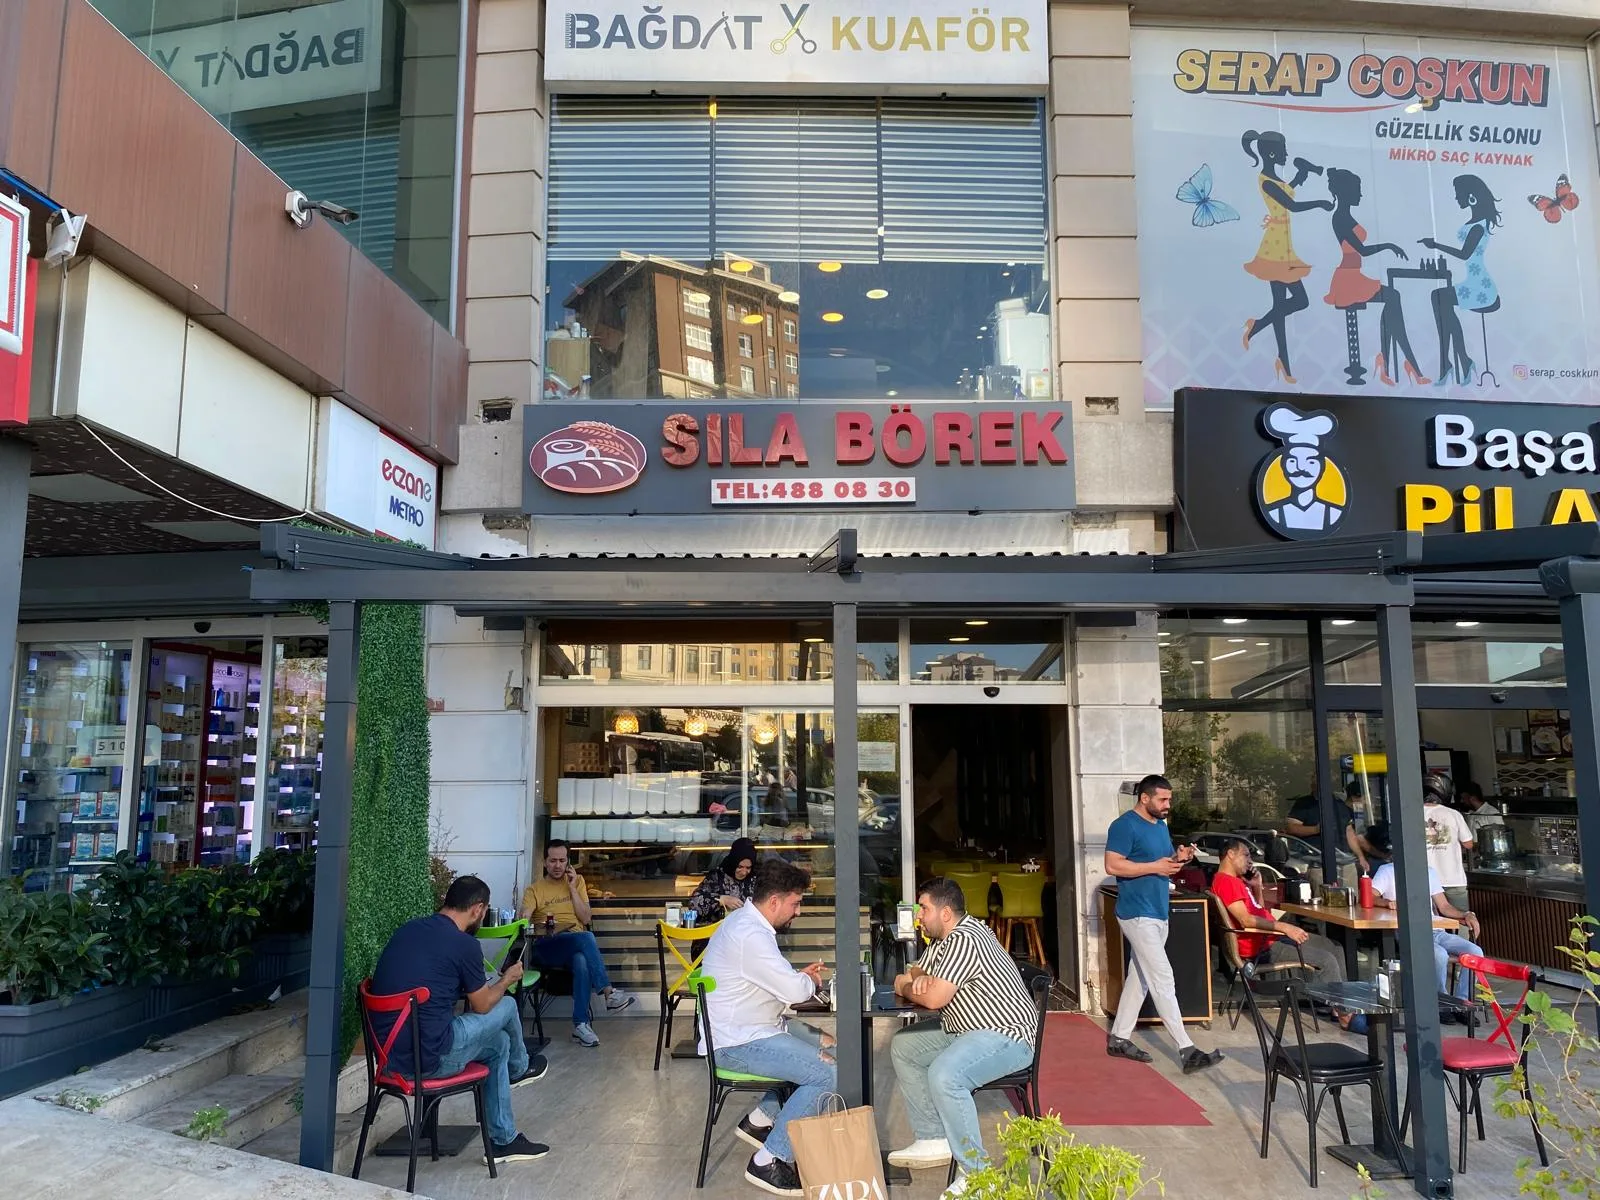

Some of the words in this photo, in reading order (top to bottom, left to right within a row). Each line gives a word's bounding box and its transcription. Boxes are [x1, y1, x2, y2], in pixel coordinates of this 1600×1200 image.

[565, 6, 763, 50] BAĞDAT
[832, 8, 1030, 51] KUAFÖR
[1173, 49, 1341, 97] SERAP
[1348, 53, 1550, 111] COŞKUN
[1375, 118, 1464, 141] GÜZELLİK
[1469, 125, 1541, 145] SALONU
[1389, 145, 1437, 162] MİKRO
[1440, 151, 1470, 167] SAÇ
[1474, 151, 1533, 166] KAYNAK
[1529, 368, 1599, 379] serap_coskkun
[661, 413, 809, 467] SILA
[835, 404, 1068, 466] BÖREK
[1434, 414, 1597, 477] Başa
[382, 458, 432, 503] eczane
[716, 482, 824, 499] TEL:488
[834, 482, 868, 499] 08
[878, 481, 911, 498] 30
[389, 495, 424, 527] METRO
